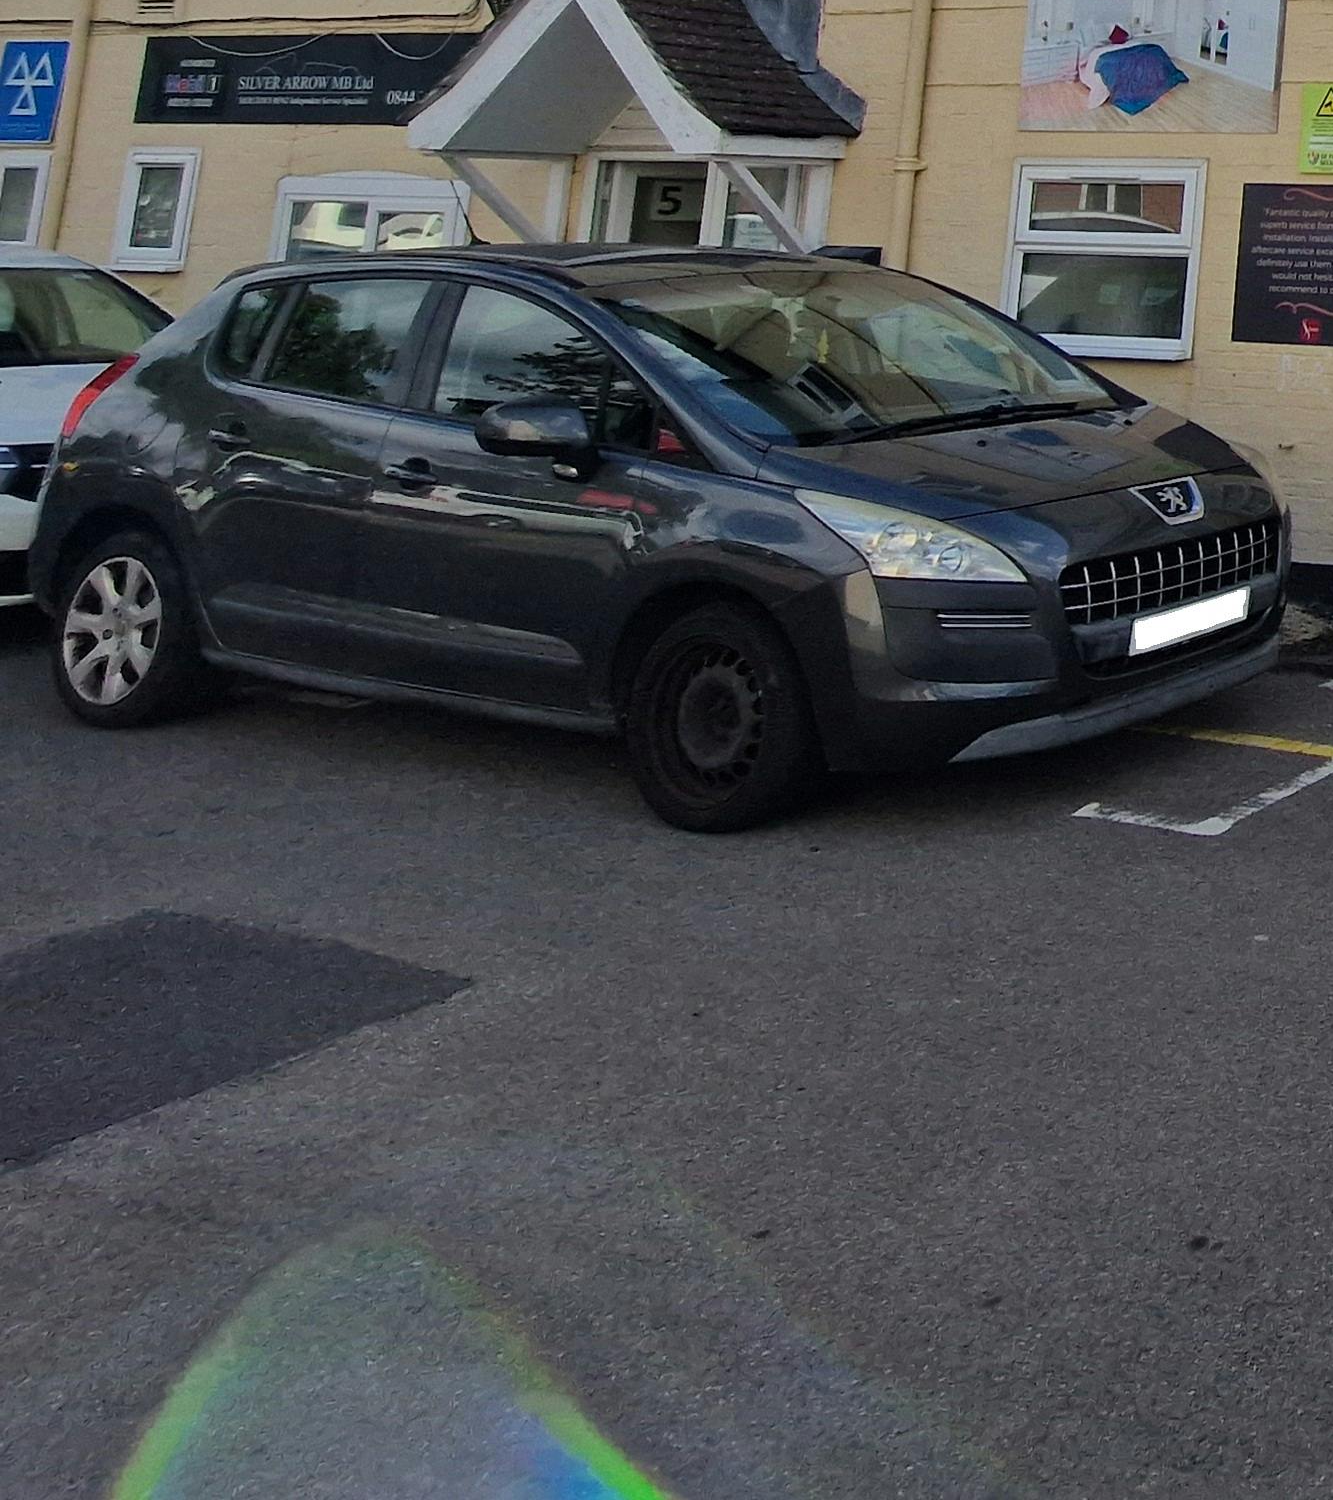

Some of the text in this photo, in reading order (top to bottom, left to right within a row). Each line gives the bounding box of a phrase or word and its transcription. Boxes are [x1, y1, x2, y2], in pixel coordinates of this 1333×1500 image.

[238, 75, 374, 90] SILVER ARROW MB Ltd
[386, 90, 416, 105] 0844
[657, 186, 682, 215] 5
[1302, 209, 1329, 218] quality
[1261, 221, 1287, 229] superb
[1251, 246, 1286, 254] aftercare
[1288, 247, 1315, 255] service
[1257, 259, 1293, 269] definitely
[1310, 260, 1331, 269] them
[1272, 272, 1296, 280] would
[1298, 273, 1312, 281] not
[1269, 285, 1318, 294] recommend
[1320, 286, 1328, 294] to
